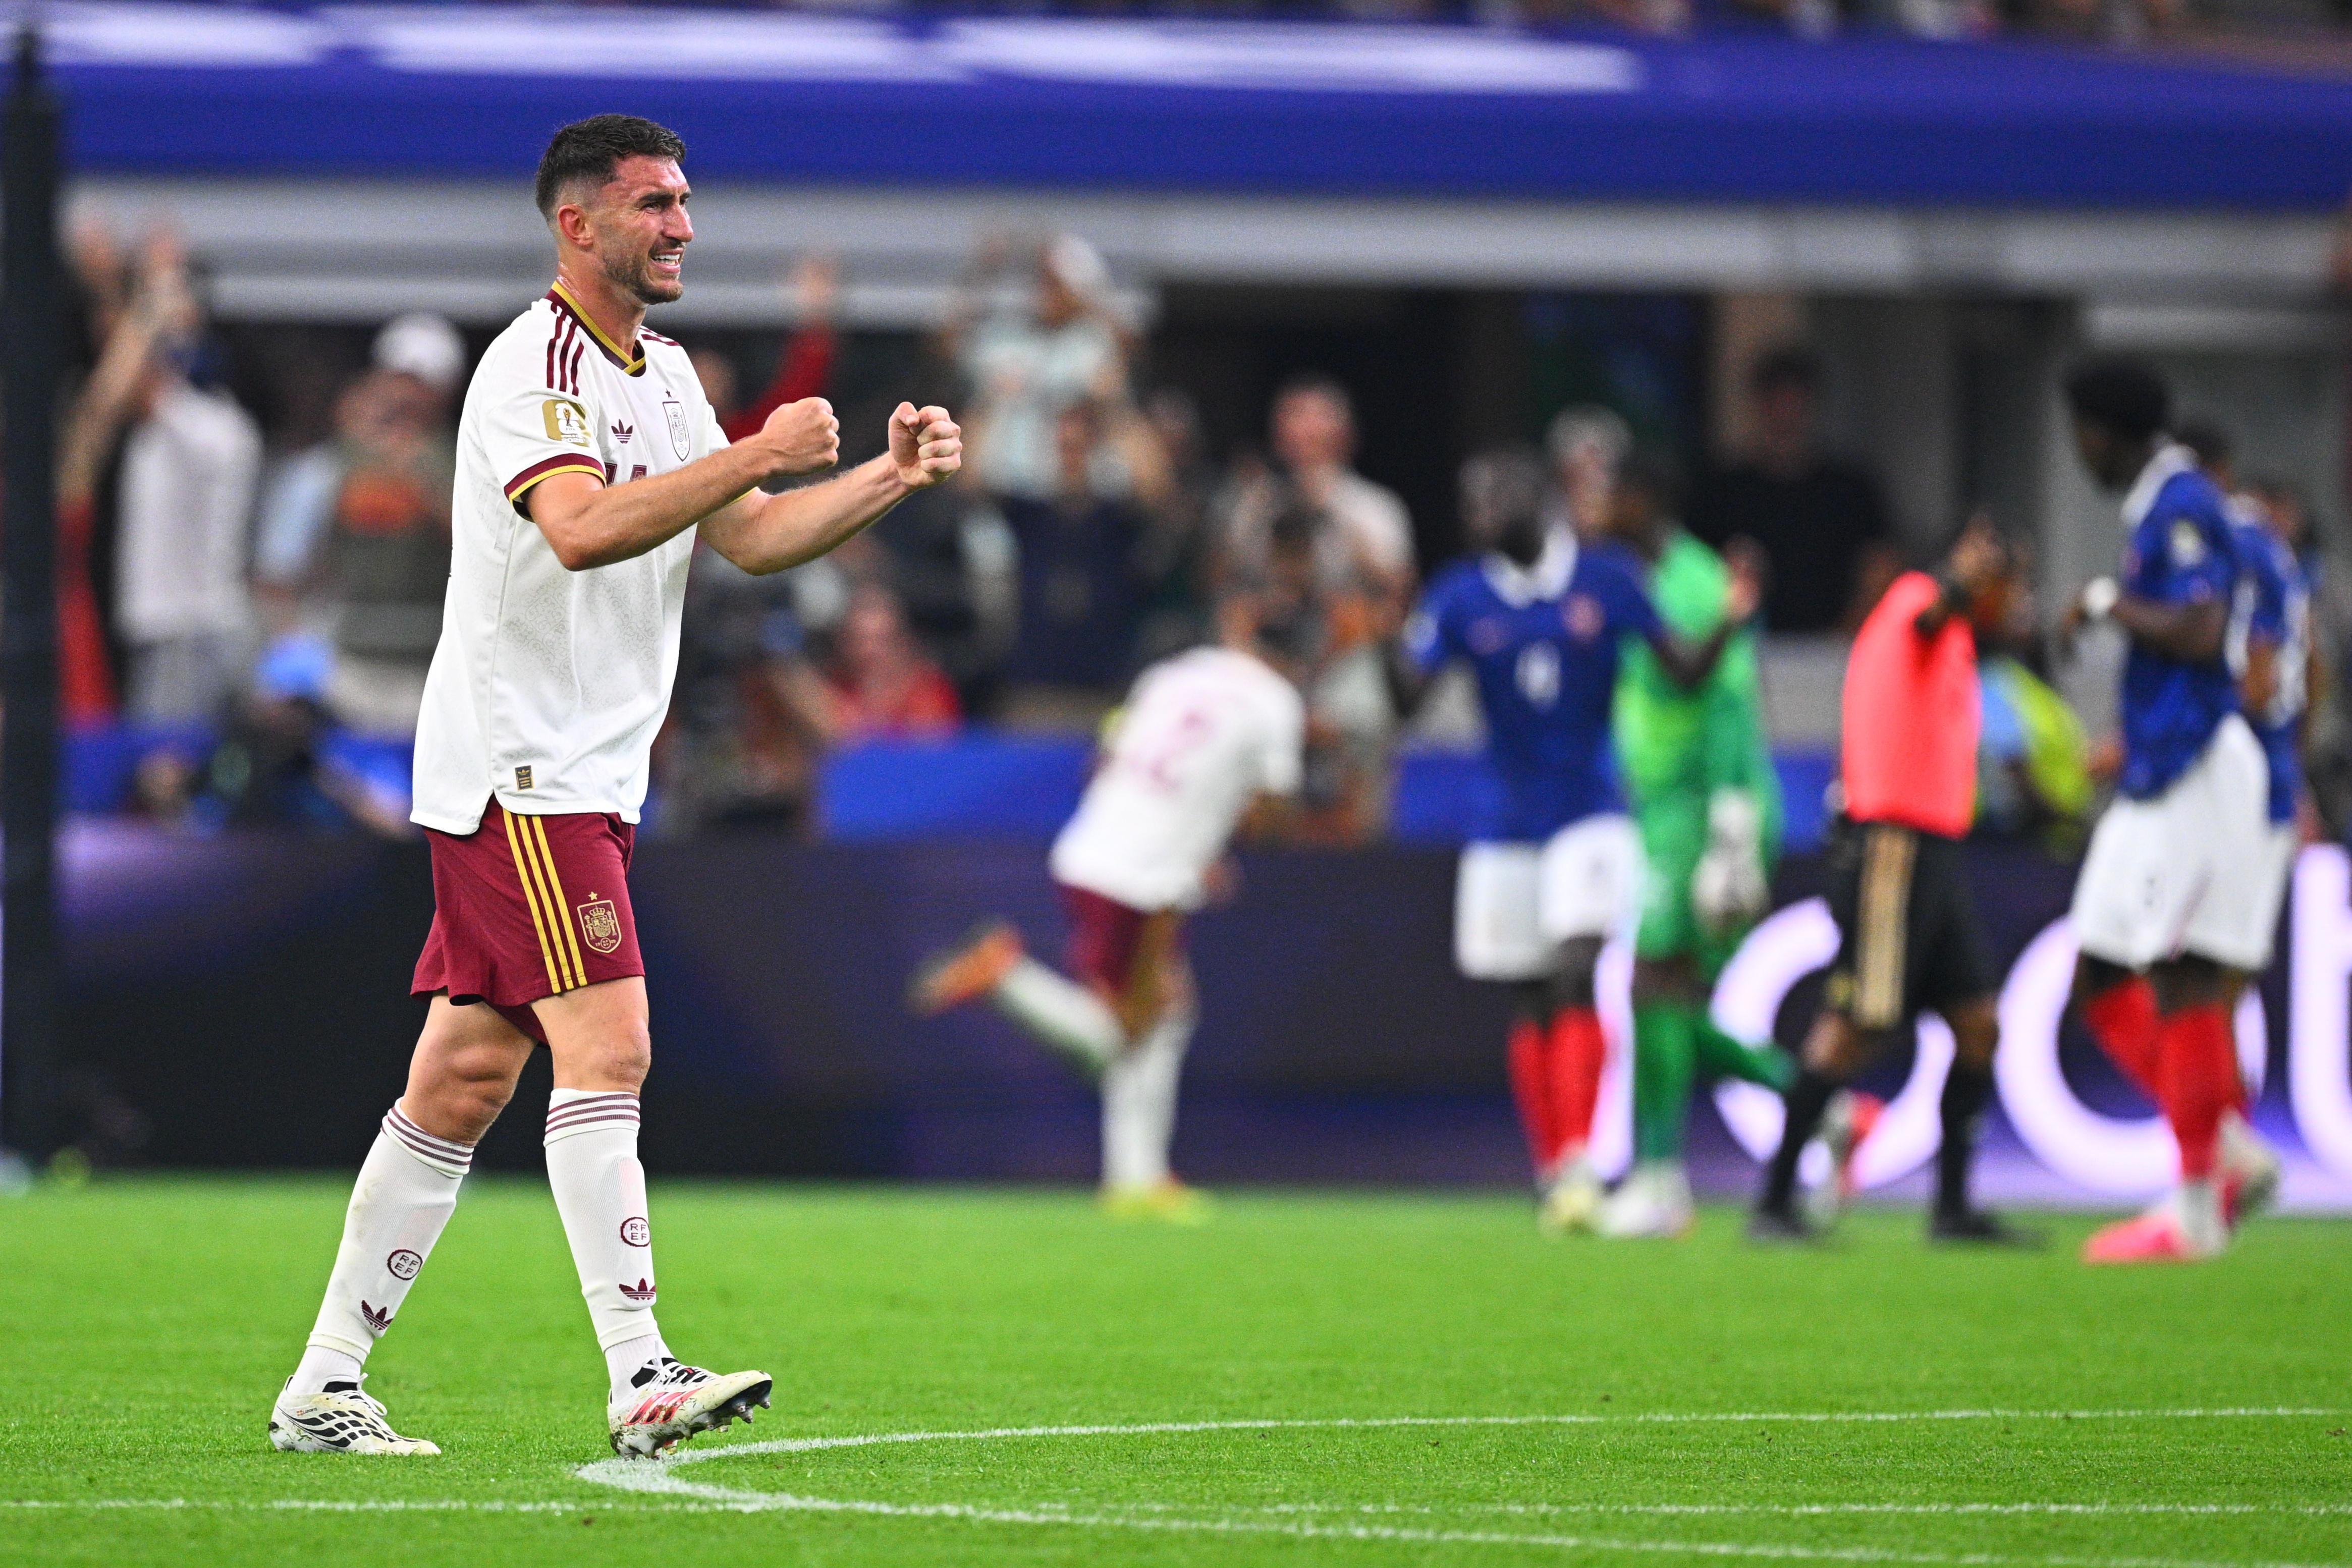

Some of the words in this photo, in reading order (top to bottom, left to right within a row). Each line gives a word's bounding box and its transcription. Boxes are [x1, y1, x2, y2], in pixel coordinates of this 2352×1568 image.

[630, 1223, 646, 1231] RF
[631, 1232, 647, 1241] EF
[399, 1254, 419, 1266] RF
[394, 1262, 414, 1274] EF
